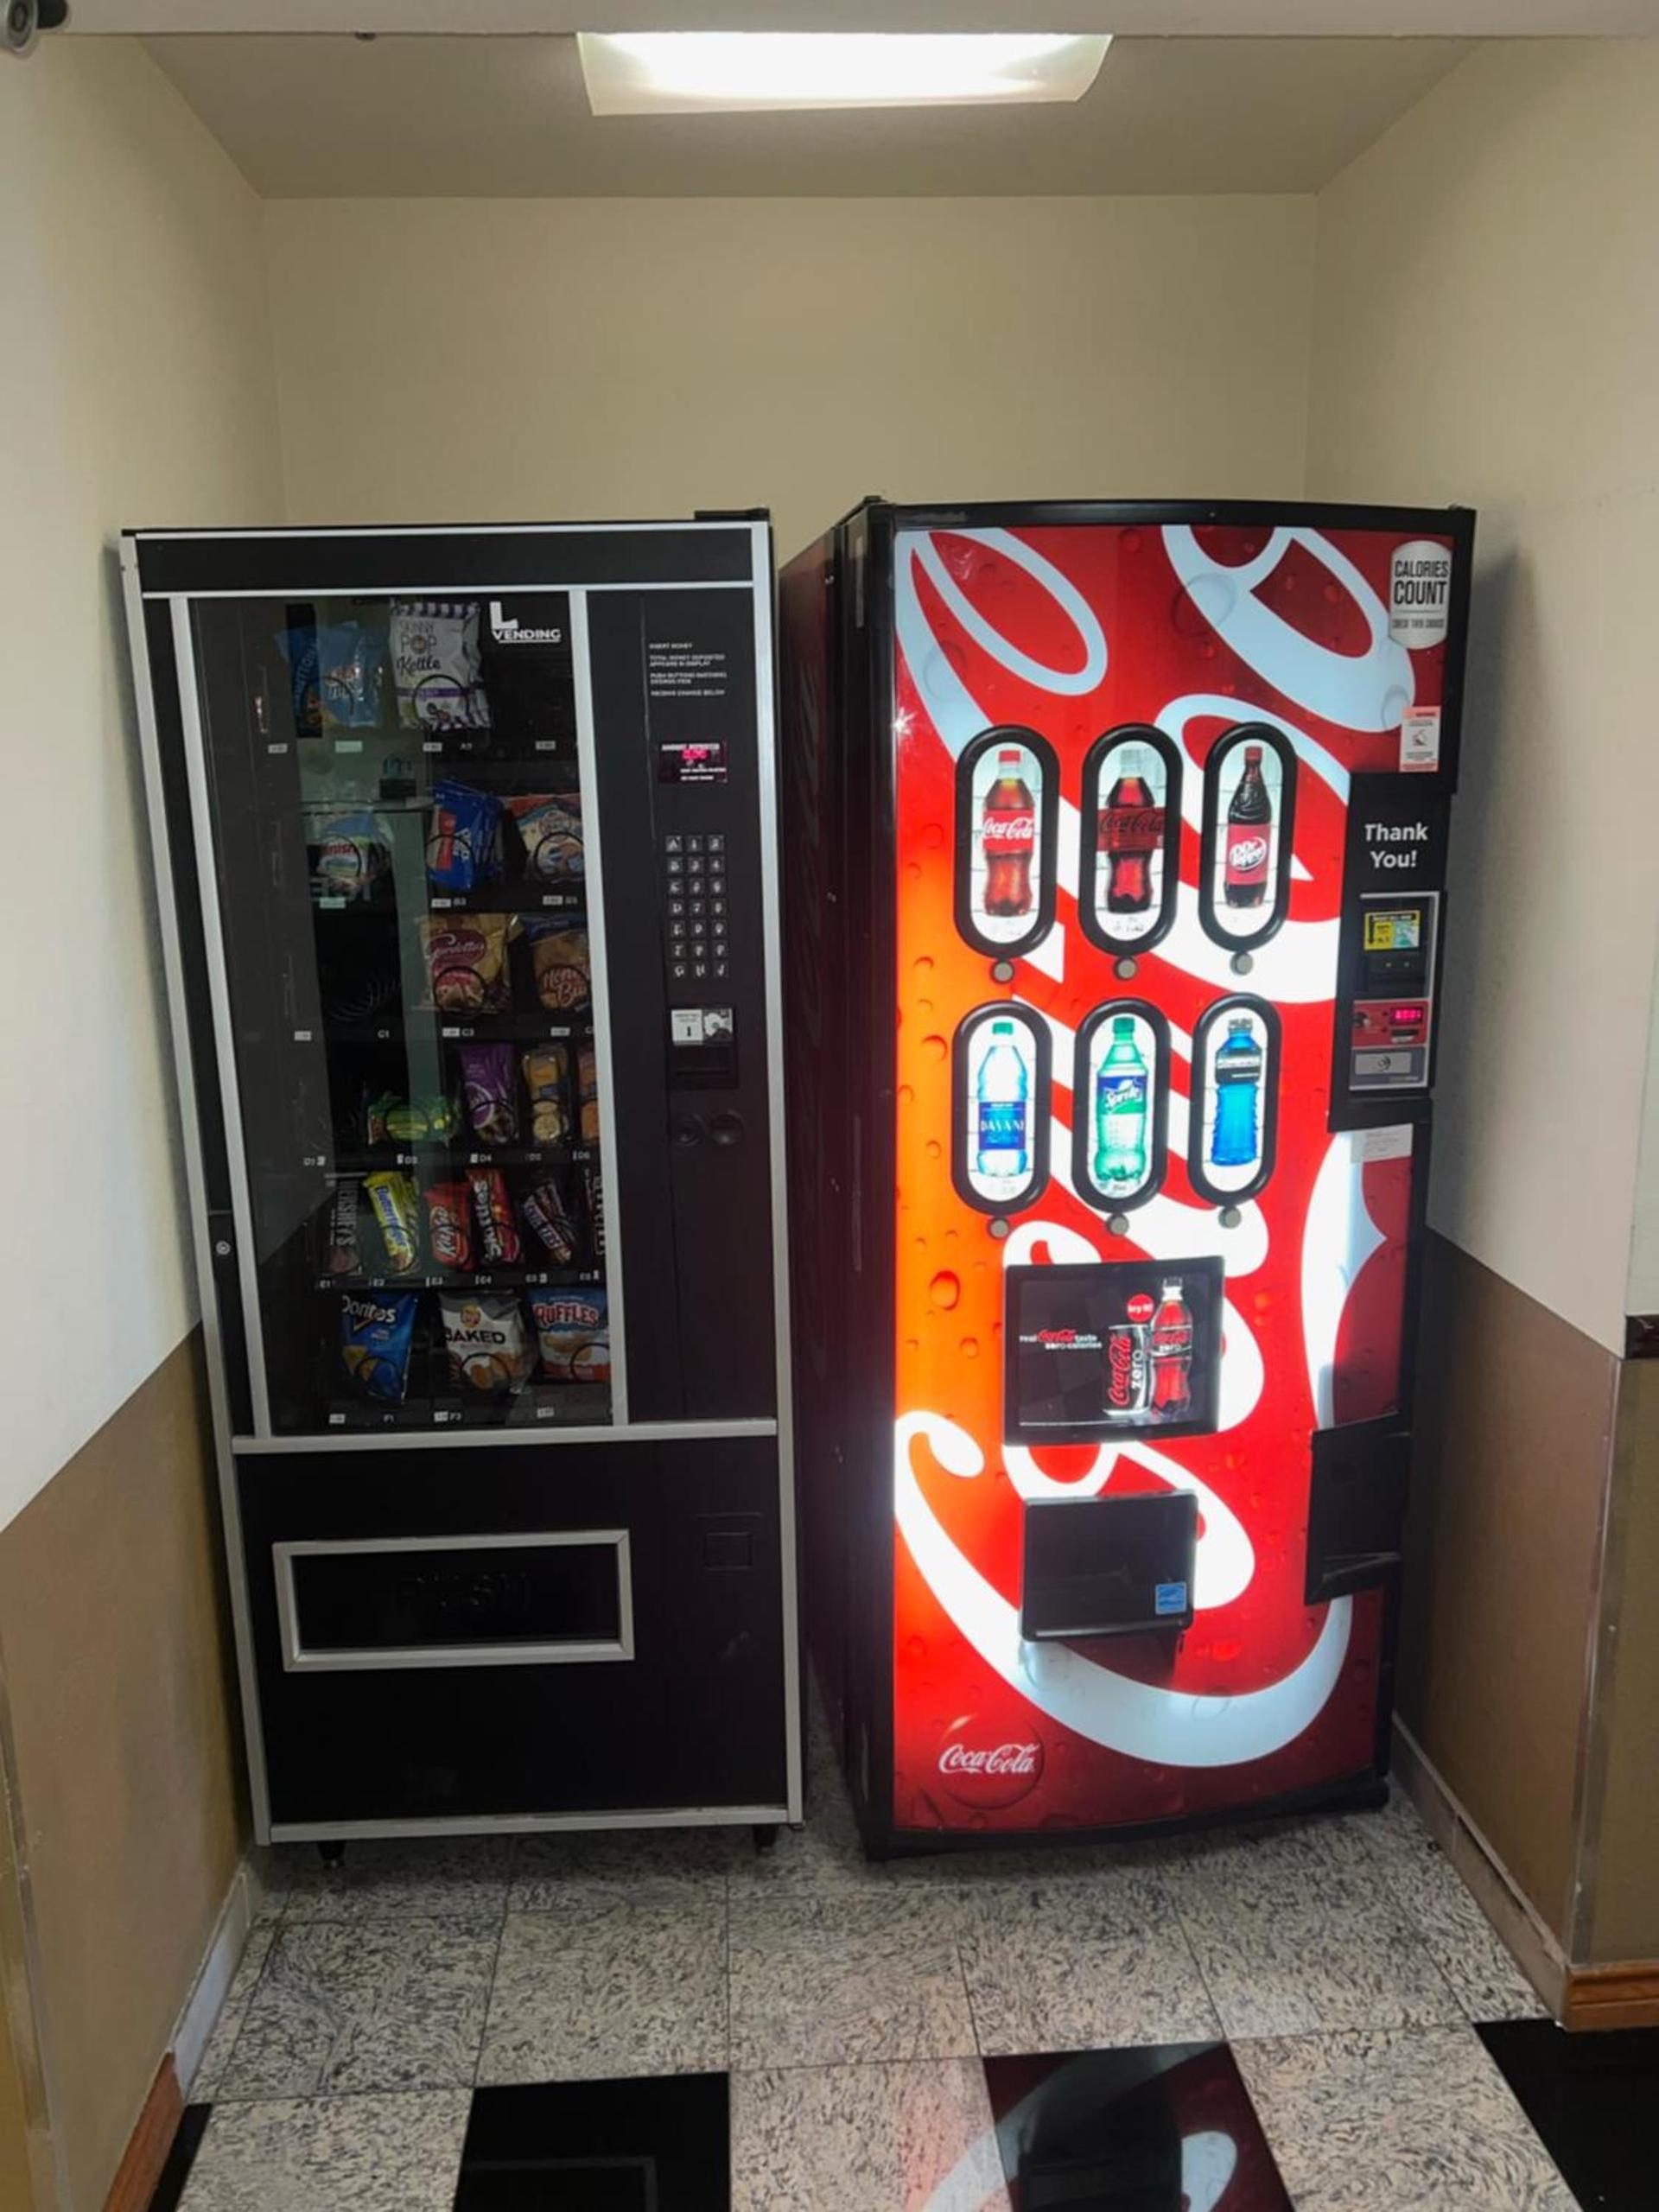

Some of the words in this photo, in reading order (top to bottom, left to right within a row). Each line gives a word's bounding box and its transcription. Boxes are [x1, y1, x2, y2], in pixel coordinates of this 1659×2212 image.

[1395, 560, 1449, 578] CALORIES
[1394, 580, 1447, 605] COUNT
[492, 628, 561, 641] VENDING
[983, 816, 1035, 841] Coca-Cola
[1363, 822, 1429, 842] Thank
[1370, 850, 1418, 868] You!
[1104, 1087, 1142, 1109] Sprite
[341, 1294, 397, 1323] Doritos
[532, 1301, 600, 1326] RUFFLES
[443, 1328, 506, 1345] BAKED
[1107, 1332, 1132, 1407] Coca-Cola
[1130, 1350, 1146, 1390] zero
[938, 1743, 1041, 1774] Coca-Cola
